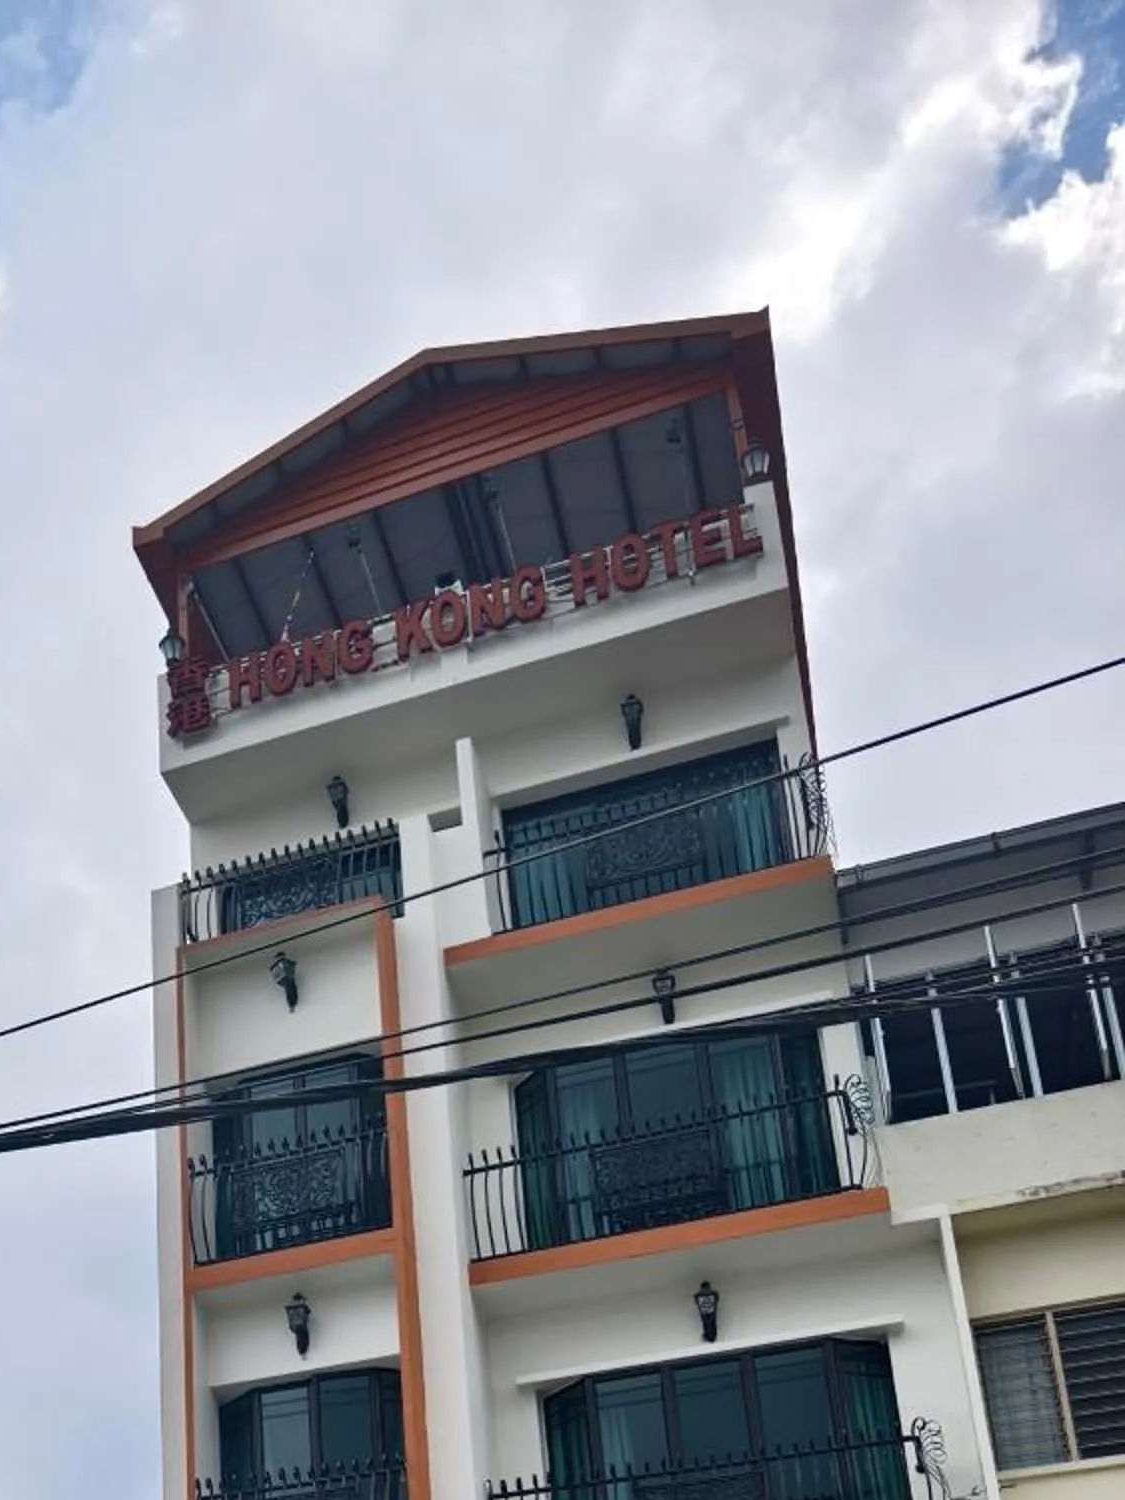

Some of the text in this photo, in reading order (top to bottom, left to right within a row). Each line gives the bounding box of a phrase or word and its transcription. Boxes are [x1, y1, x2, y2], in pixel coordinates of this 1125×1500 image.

[228, 503, 764, 710] HONG KONG HOTEL
